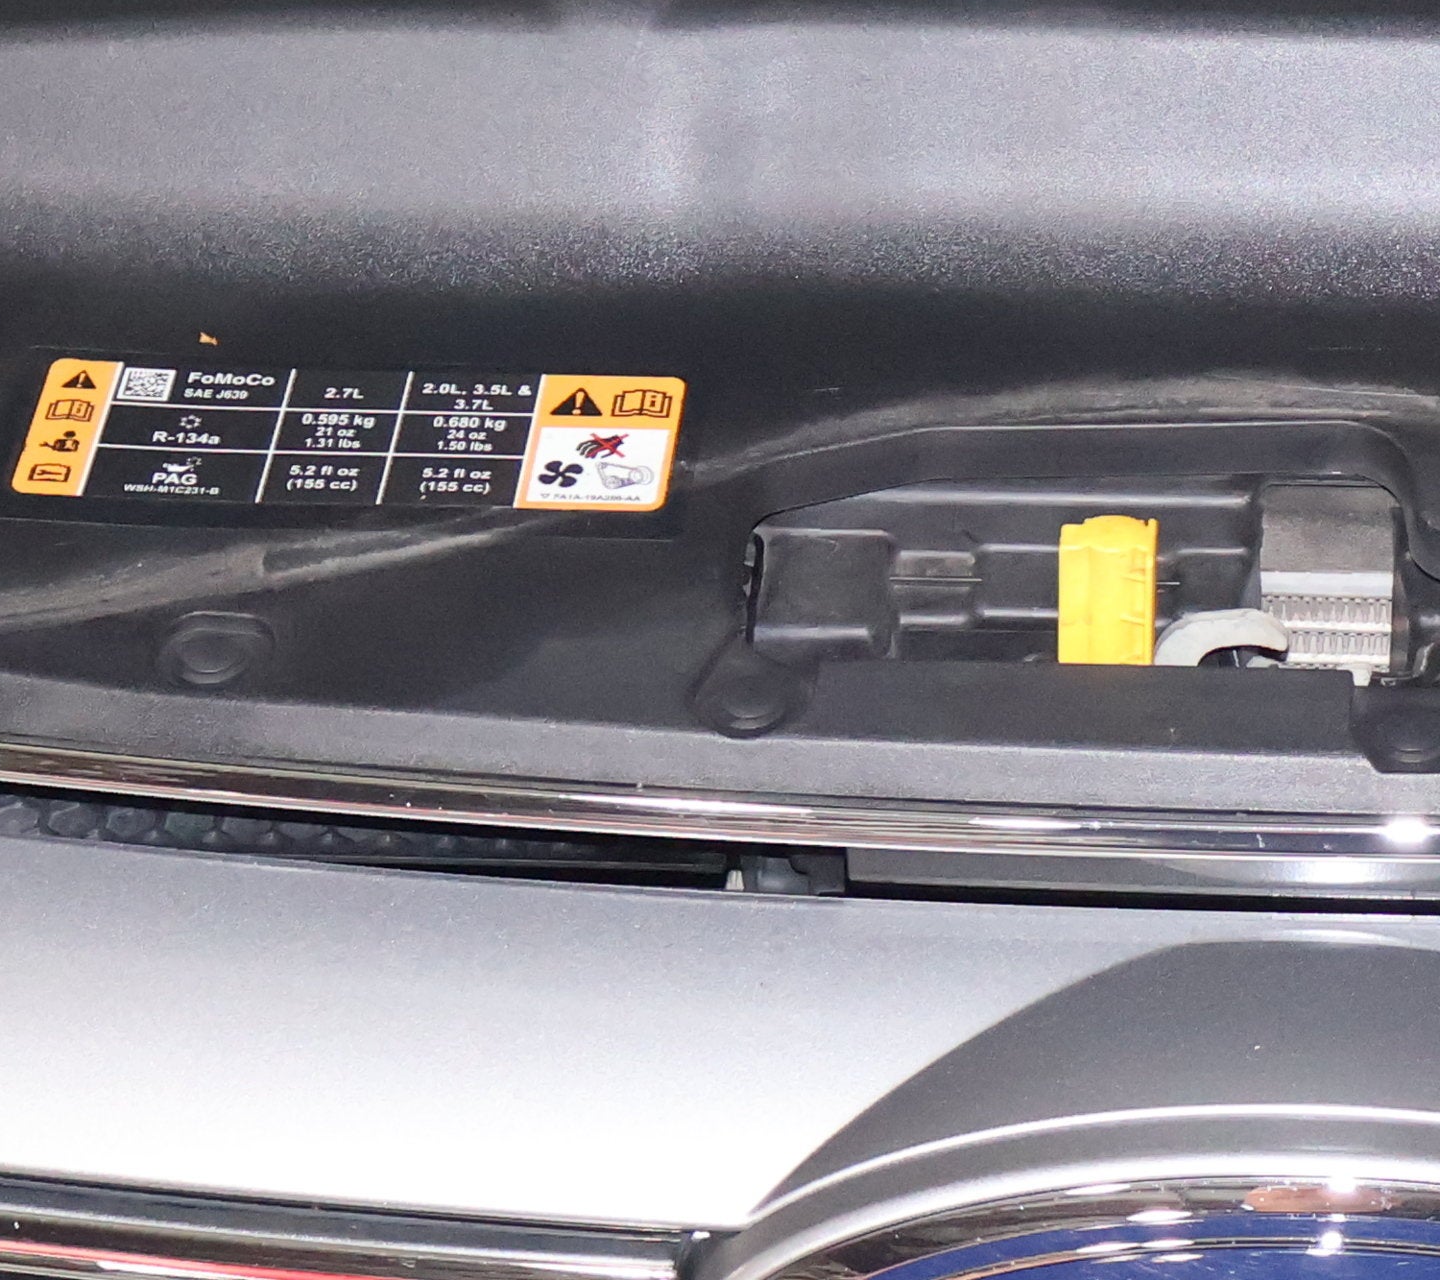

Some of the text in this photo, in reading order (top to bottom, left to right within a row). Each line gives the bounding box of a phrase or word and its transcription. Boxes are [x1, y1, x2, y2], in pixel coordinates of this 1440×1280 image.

[187, 371, 275, 386] FoMoCo
[183, 388, 249, 400] SAE J639
[324, 388, 364, 400] 2.7L
[473, 384, 512, 396] 3.5L
[518, 385, 532, 396] &
[454, 399, 494, 411] 3.7L
[302, 414, 376, 429] 0.595 kg
[433, 416, 507, 431] 0.680 kg
[152, 430, 221, 445] R-134a
[315, 427, 357, 438] 21 oz
[447, 430, 487, 441] 24 oz
[305, 438, 361, 449] 1.31 lbs
[437, 440, 493, 452] 1.50 lbs
[289, 465, 360, 477] 5.2 fl oz
[422, 468, 492, 480] 5.2 fl oz
[152, 472, 198, 485] PAG
[286, 478, 358, 491] (155 cc)
[419, 481, 491, 494] (155 cc)
